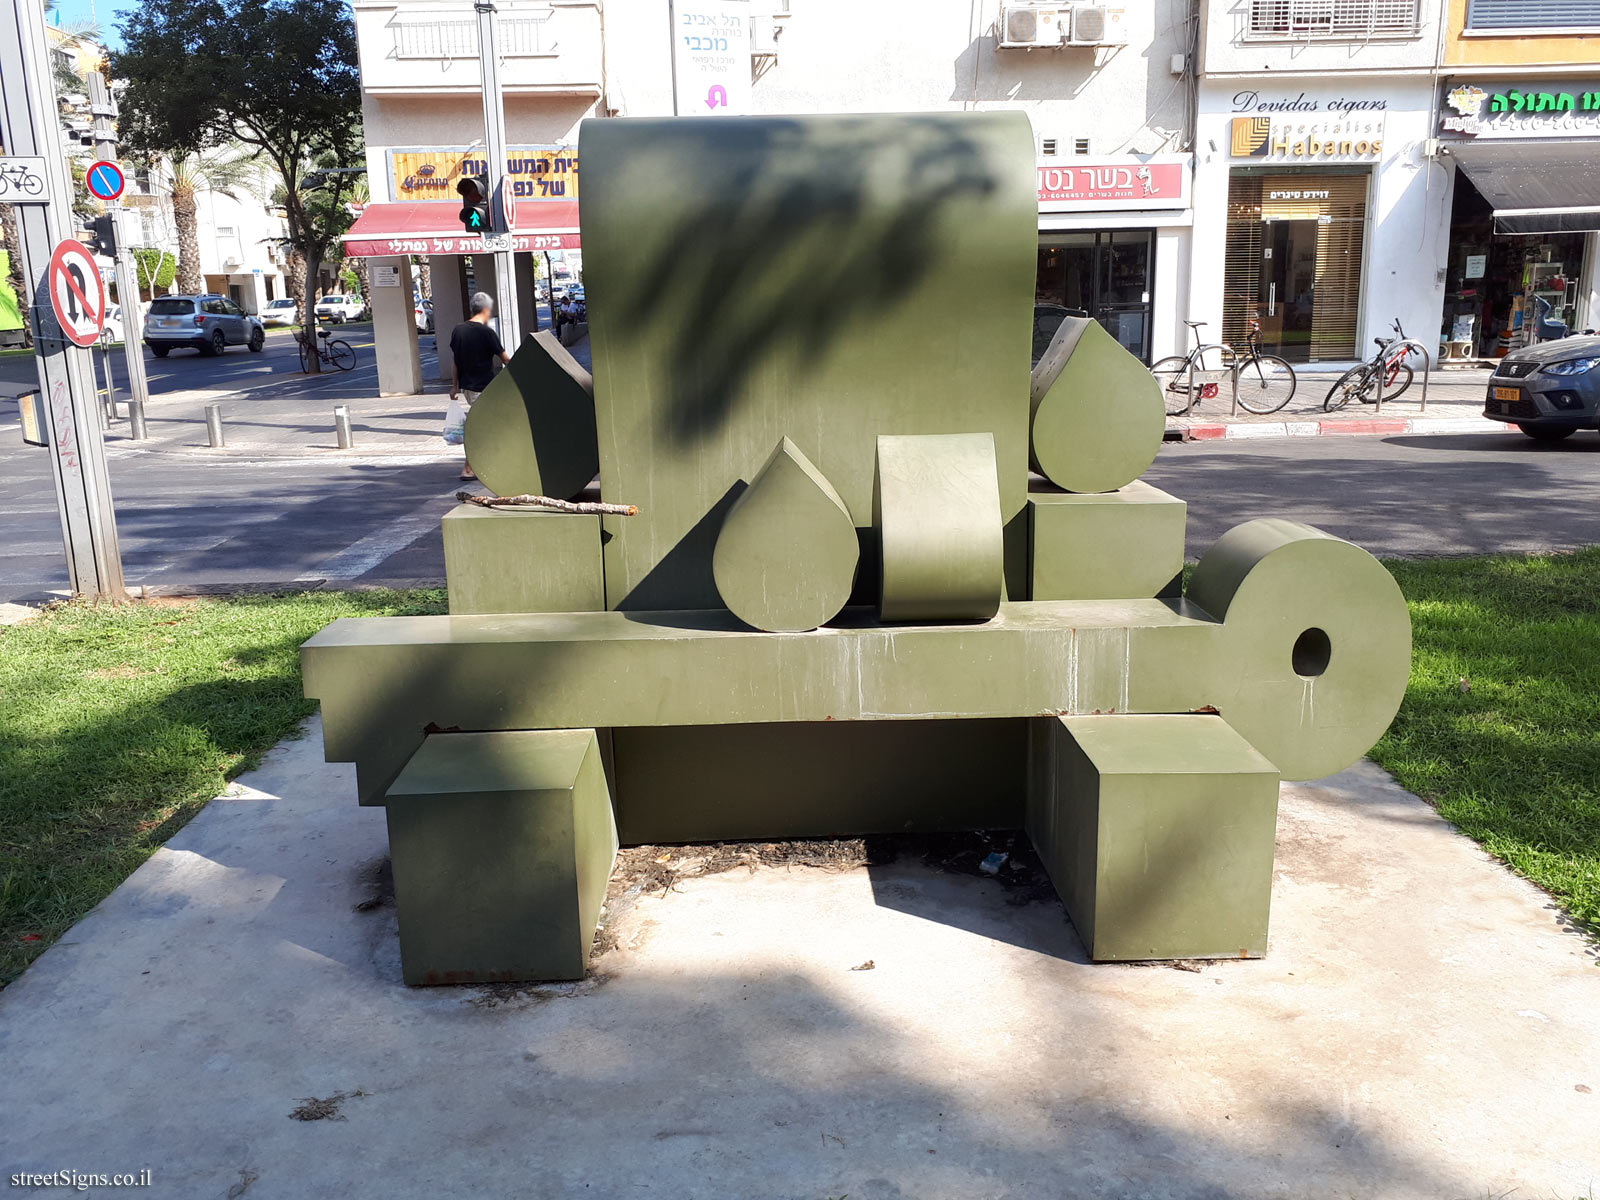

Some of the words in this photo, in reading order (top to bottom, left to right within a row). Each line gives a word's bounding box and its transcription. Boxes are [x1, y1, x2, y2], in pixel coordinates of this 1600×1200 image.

[683, 13, 716, 25] אביב
[721, 12, 741, 27] תל
[1232, 90, 1319, 113] Devidas
[1327, 97, 1388, 120] cigars
[1492, 89, 1575, 112] חתולה
[1271, 121, 1383, 136] specialist
[1272, 134, 1384, 156] Habanos
[404, 174, 449, 189] Corona
[1081, 168, 1134, 190] בשר
[538, 178, 565, 196] של
[388, 239, 428, 253] נפתלי
[434, 238, 454, 251] של
[535, 236, 562, 248] בית
